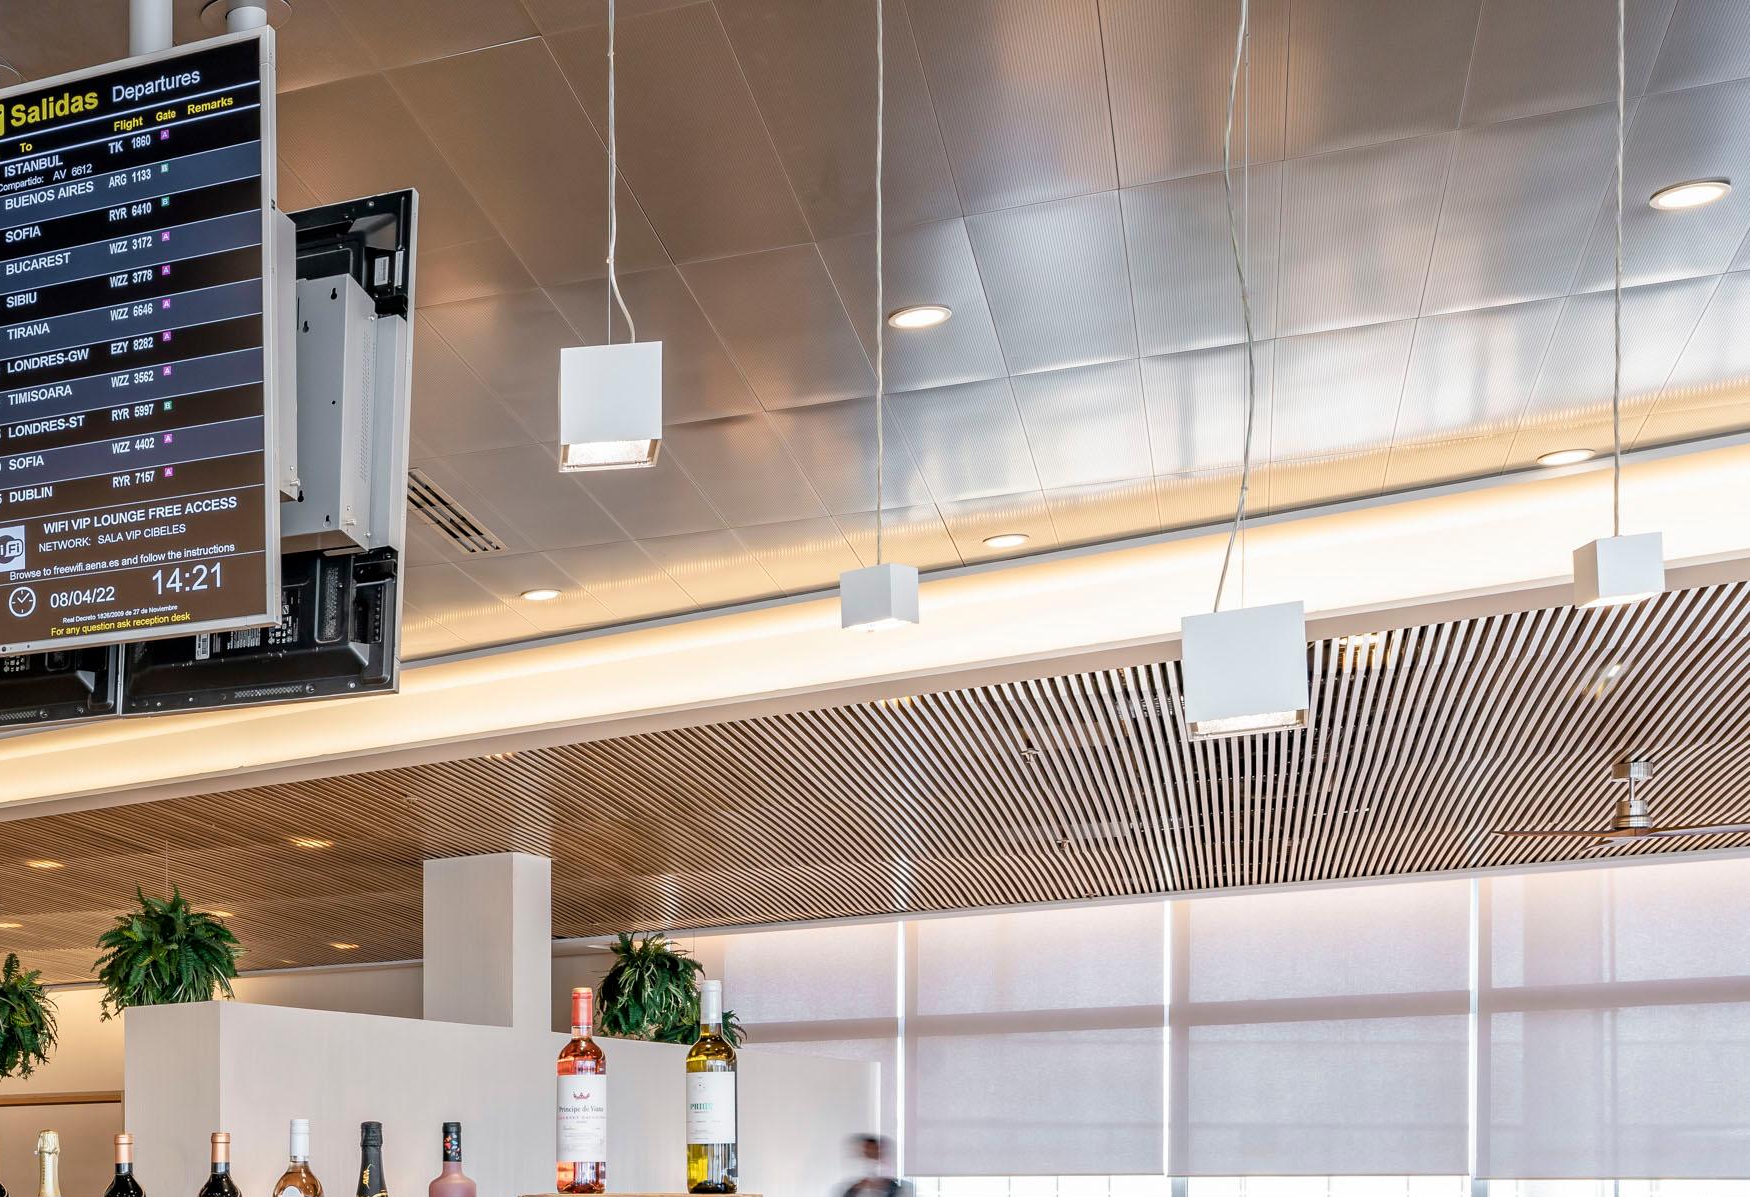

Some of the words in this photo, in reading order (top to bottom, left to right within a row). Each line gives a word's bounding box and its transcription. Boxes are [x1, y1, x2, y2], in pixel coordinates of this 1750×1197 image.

[10, 92, 98, 127] Salidas
[112, 70, 200, 102] Departures
[20, 142, 32, 152] To
[114, 116, 143, 132] Flight
[156, 110, 176, 122] Gate
[188, 97, 233, 114] Remarks
[4, 155, 63, 177] ISTANBUL
[53, 170, 66, 181] AV
[72, 164, 92, 177] 6612
[5, 190, 54, 210] BUENOS
[58, 181, 94, 198] AIRES
[5, 226, 41, 244] SOFIA
[6, 252, 70, 276] BUCAREST
[6, 292, 37, 308] SIBIU
[8, 322, 50, 341] TIRANA
[7, 349, 89, 374] LONDRES-GW
[8, 384, 72, 405] TIMISOARA
[9, 415, 85, 438] LONDRES-ST
[9, 455, 44, 470] SOFIA
[9, 486, 52, 502] DUBLIN
[44, 520, 69, 534] WIFI
[71, 517, 90, 530] VIP
[94, 509, 145, 528] LOUNGE
[149, 504, 181, 520] FREE
[185, 496, 237, 514] ACCESS
[39, 538, 91, 552] NETWORK:
[98, 533, 124, 544] SALA
[126, 531, 142, 541] VIP
[144, 524, 186, 538] CIBELES
[10, 570, 41, 581] Browse
[43, 568, 52, 576] to
[53, 559, 119, 575] freewifi.aena.es
[121, 557, 138, 566] and
[140, 552, 166, 563] follow
[168, 550, 182, 559] the
[184, 543, 235, 557] instructions
[50, 586, 115, 609] 08/04/22
[153, 562, 222, 594] 14:21
[51, 627, 64, 636] For
[66, 626, 80, 636] any
[82, 621, 115, 634] question
[117, 619, 131, 628] ask
[133, 615, 169, 629] reception
[171, 612, 190, 622] desk
